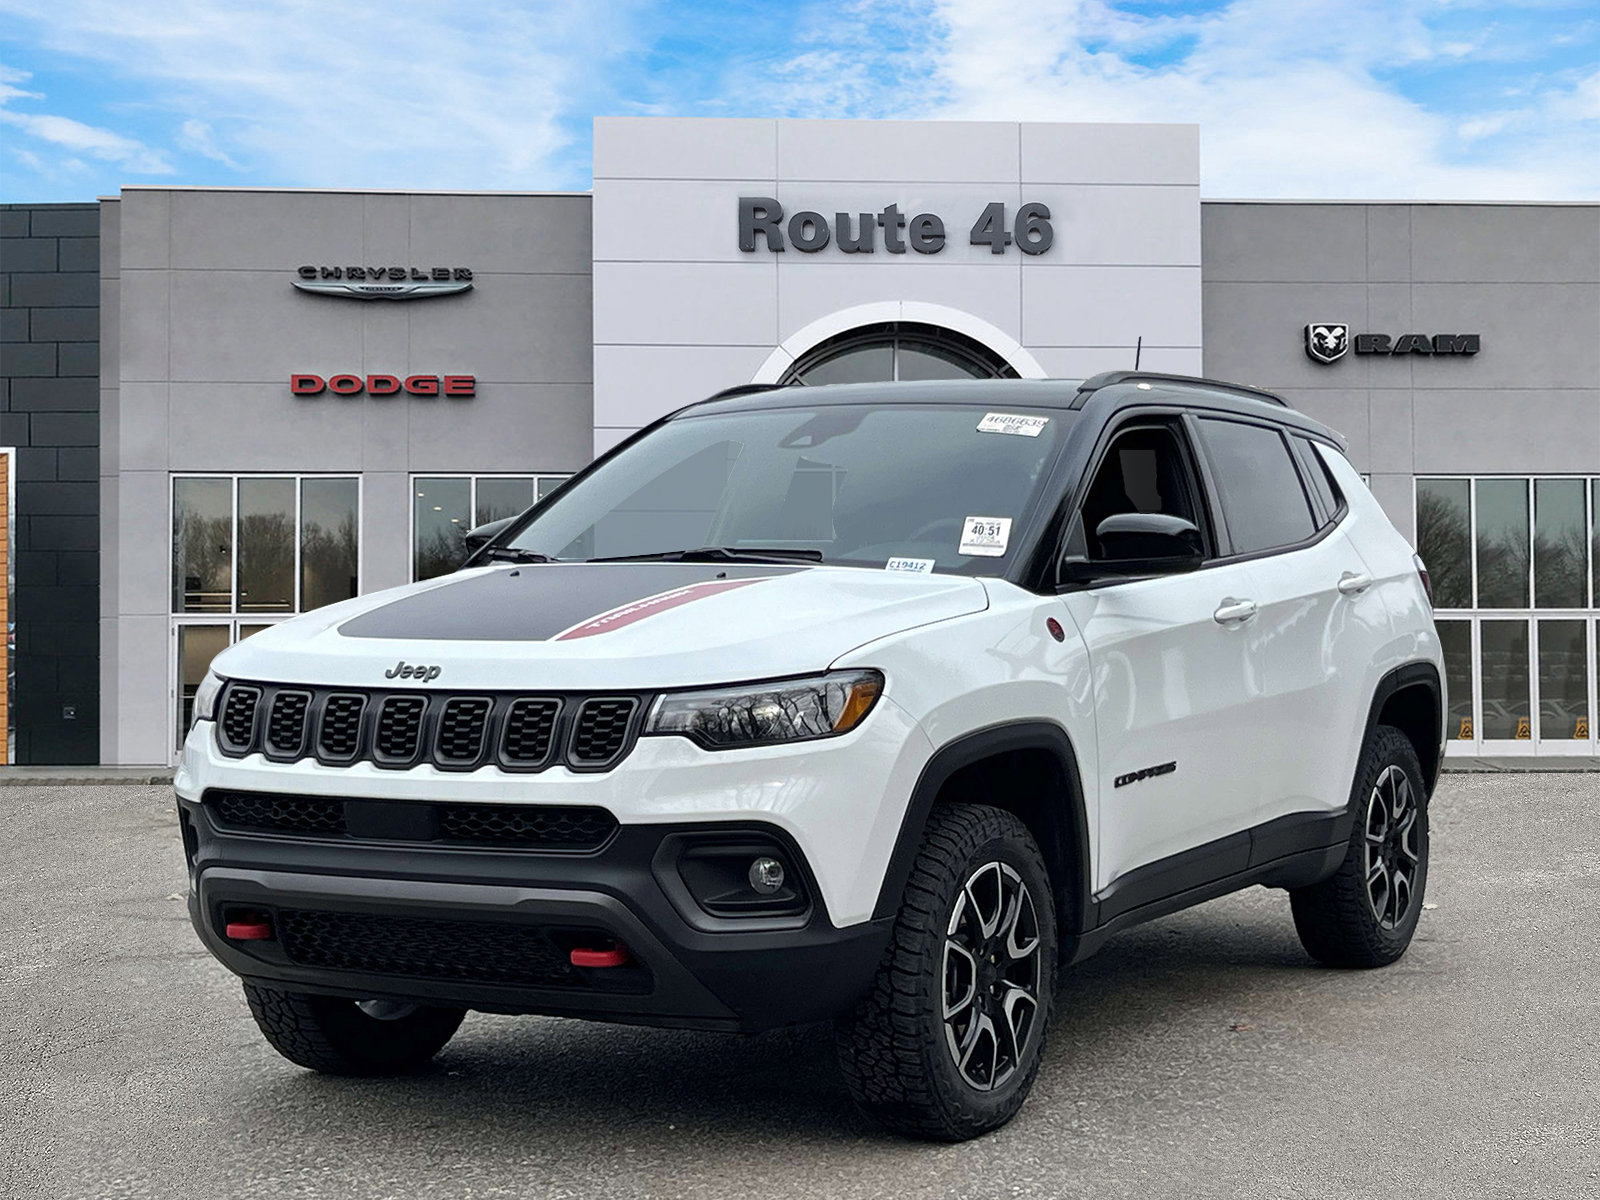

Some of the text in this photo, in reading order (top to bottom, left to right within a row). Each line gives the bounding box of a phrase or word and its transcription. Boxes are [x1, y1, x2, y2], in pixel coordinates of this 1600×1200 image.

[738, 196, 1055, 256] Route 46
[297, 265, 474, 281] CHRYSLER
[1354, 333, 1481, 356] RAM
[290, 374, 477, 397] DODGE
[384, 661, 442, 683] Jeep
